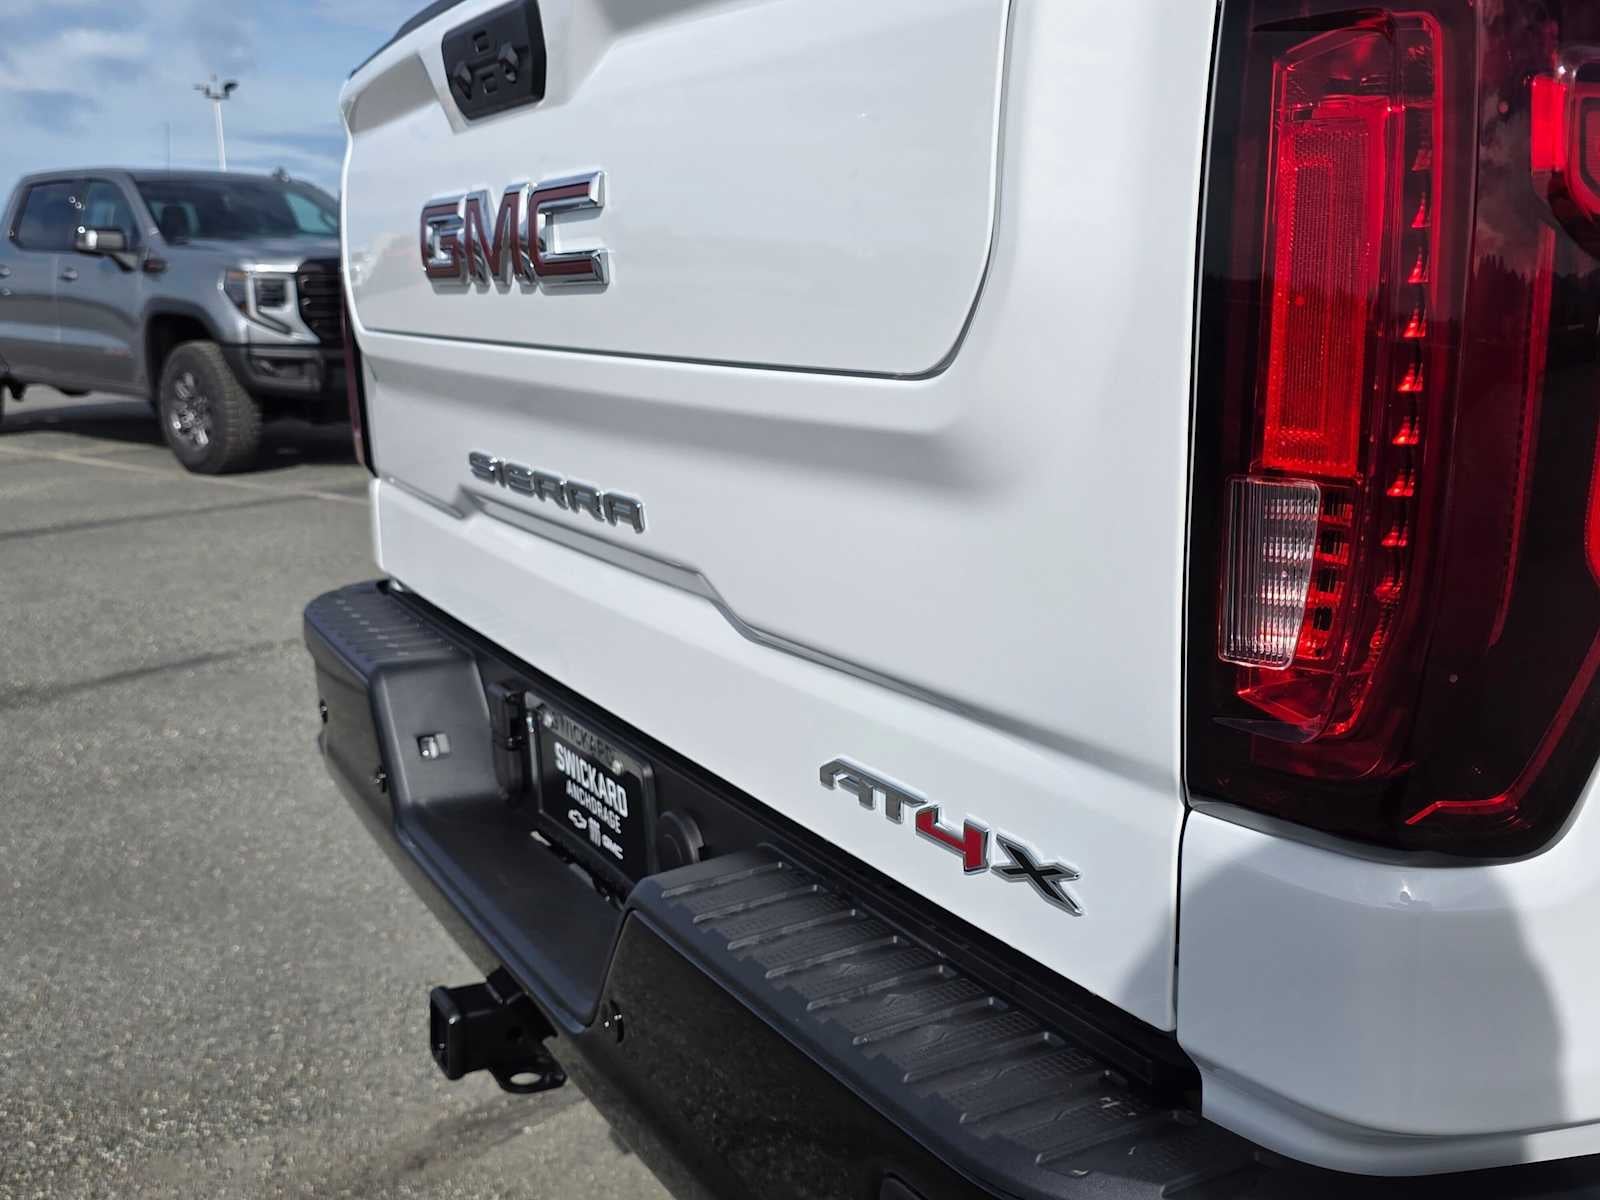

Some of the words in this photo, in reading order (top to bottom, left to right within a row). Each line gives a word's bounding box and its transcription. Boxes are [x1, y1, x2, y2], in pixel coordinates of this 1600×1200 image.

[420, 171, 610, 294] GMC
[468, 451, 646, 534] SIERRA
[554, 741, 629, 819] SWICKARD
[566, 779, 622, 834] ANCHORAGE
[819, 757, 1083, 917] AT4X
